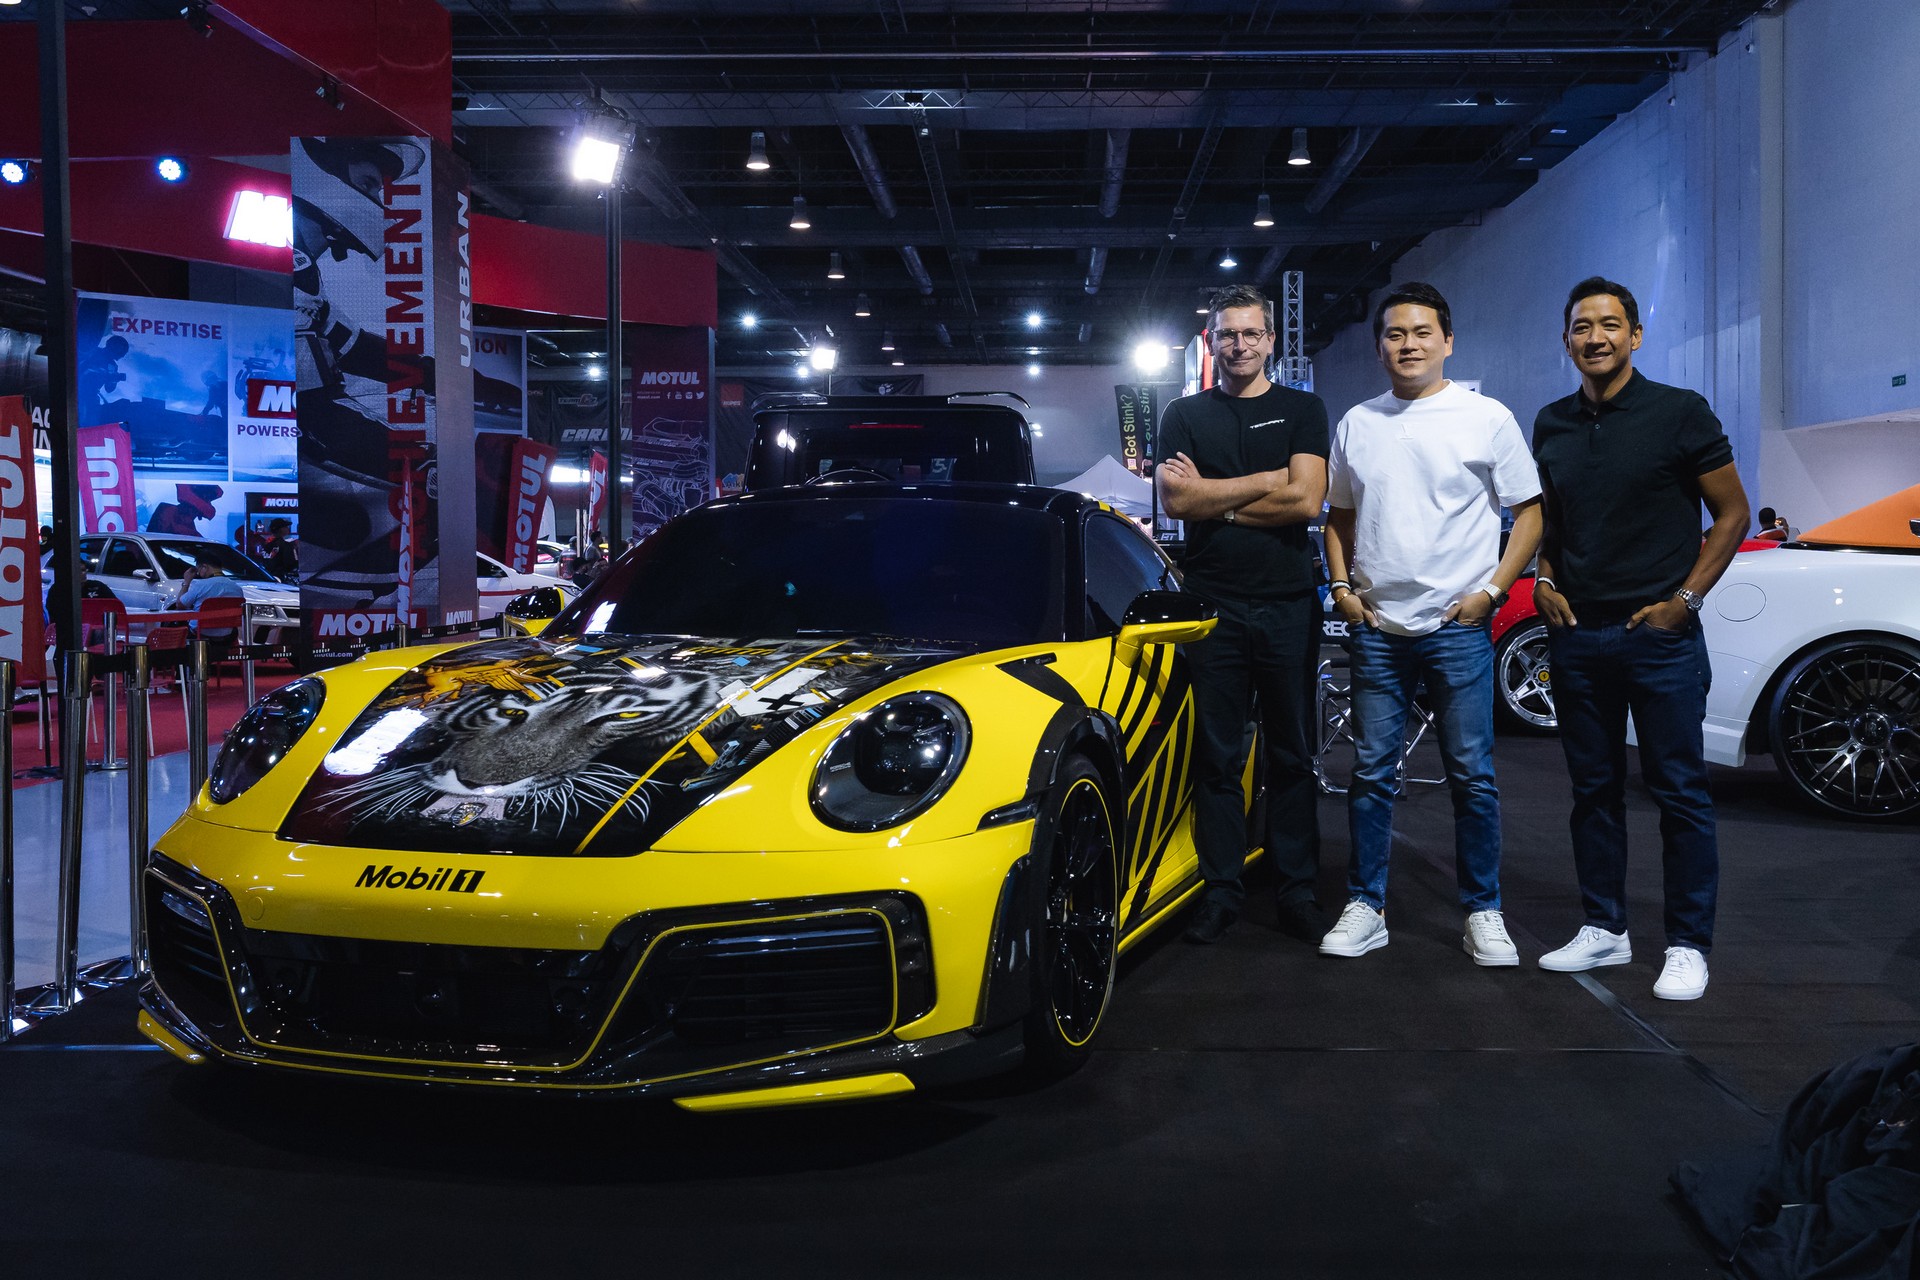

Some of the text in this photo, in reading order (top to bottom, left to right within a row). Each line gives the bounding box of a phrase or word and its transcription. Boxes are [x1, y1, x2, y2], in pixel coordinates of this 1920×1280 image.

[223, 189, 294, 249] M
[457, 191, 472, 368] URBAN
[112, 317, 222, 340] EXPERTISE
[383, 176, 428, 560] ACHIEVEMENT
[641, 372, 699, 385] MOTUL
[257, 385, 296, 413] M
[237, 424, 299, 438] POWERS
[561, 427, 632, 442] CAR
[1120, 393, 1137, 458] Got Stink?
[265, 498, 298, 507] MOTU
[512, 453, 548, 575] MOTUL
[355, 865, 453, 891] Mobil
